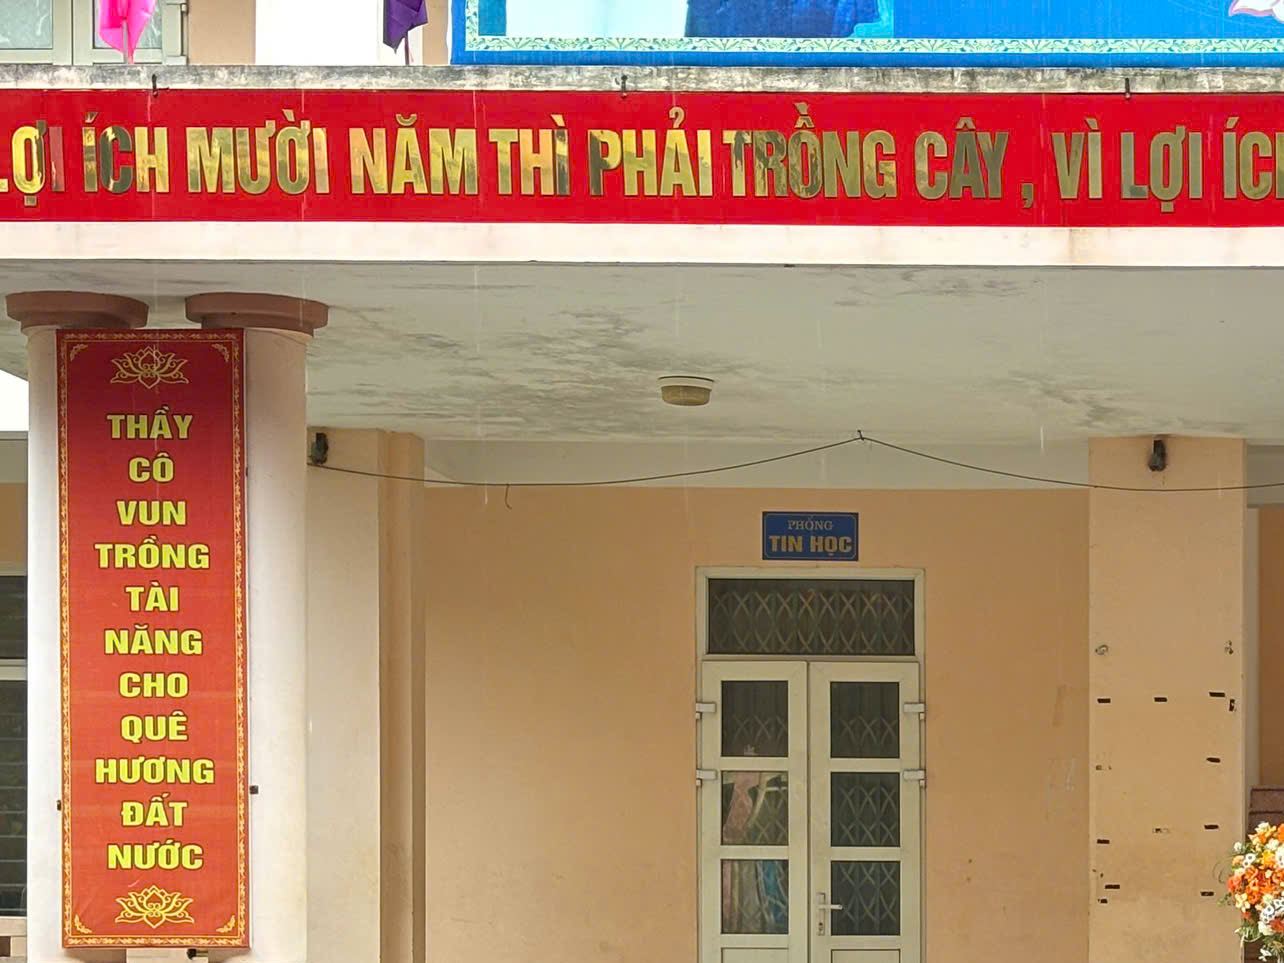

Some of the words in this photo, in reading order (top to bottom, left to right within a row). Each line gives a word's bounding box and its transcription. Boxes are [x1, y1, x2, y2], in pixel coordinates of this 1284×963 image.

[0, 120, 65, 206] ỢI
[82, 111, 169, 193] ÍCH
[186, 108, 329, 194] MƯỜI
[349, 113, 478, 194] NĂM
[489, 114, 569, 195] THÌ
[588, 107, 713, 196] PHẢI
[722, 102, 897, 199] TRỒNG
[915, 117, 1009, 199] CÂY
[1051, 117, 1102, 199] VÌ
[1120, 125, 1202, 213] LỢI
[106, 405, 193, 440] THẦY
[128, 452, 175, 483] CÔ
[116, 500, 187, 526] VUN
[94, 536, 211, 569] TRỒNG
[768, 535, 803, 553] TIN
[810, 535, 852, 556] HỌC
[125, 581, 179, 612] TÀI
[104, 624, 203, 655] NĂNG
[118, 672, 190, 698] CHO
[120, 710, 189, 742] QUÊ
[94, 755, 216, 784] HƯƠNG
[120, 793, 188, 827] ĐẤT
[106, 839, 204, 870] NƯỚC
